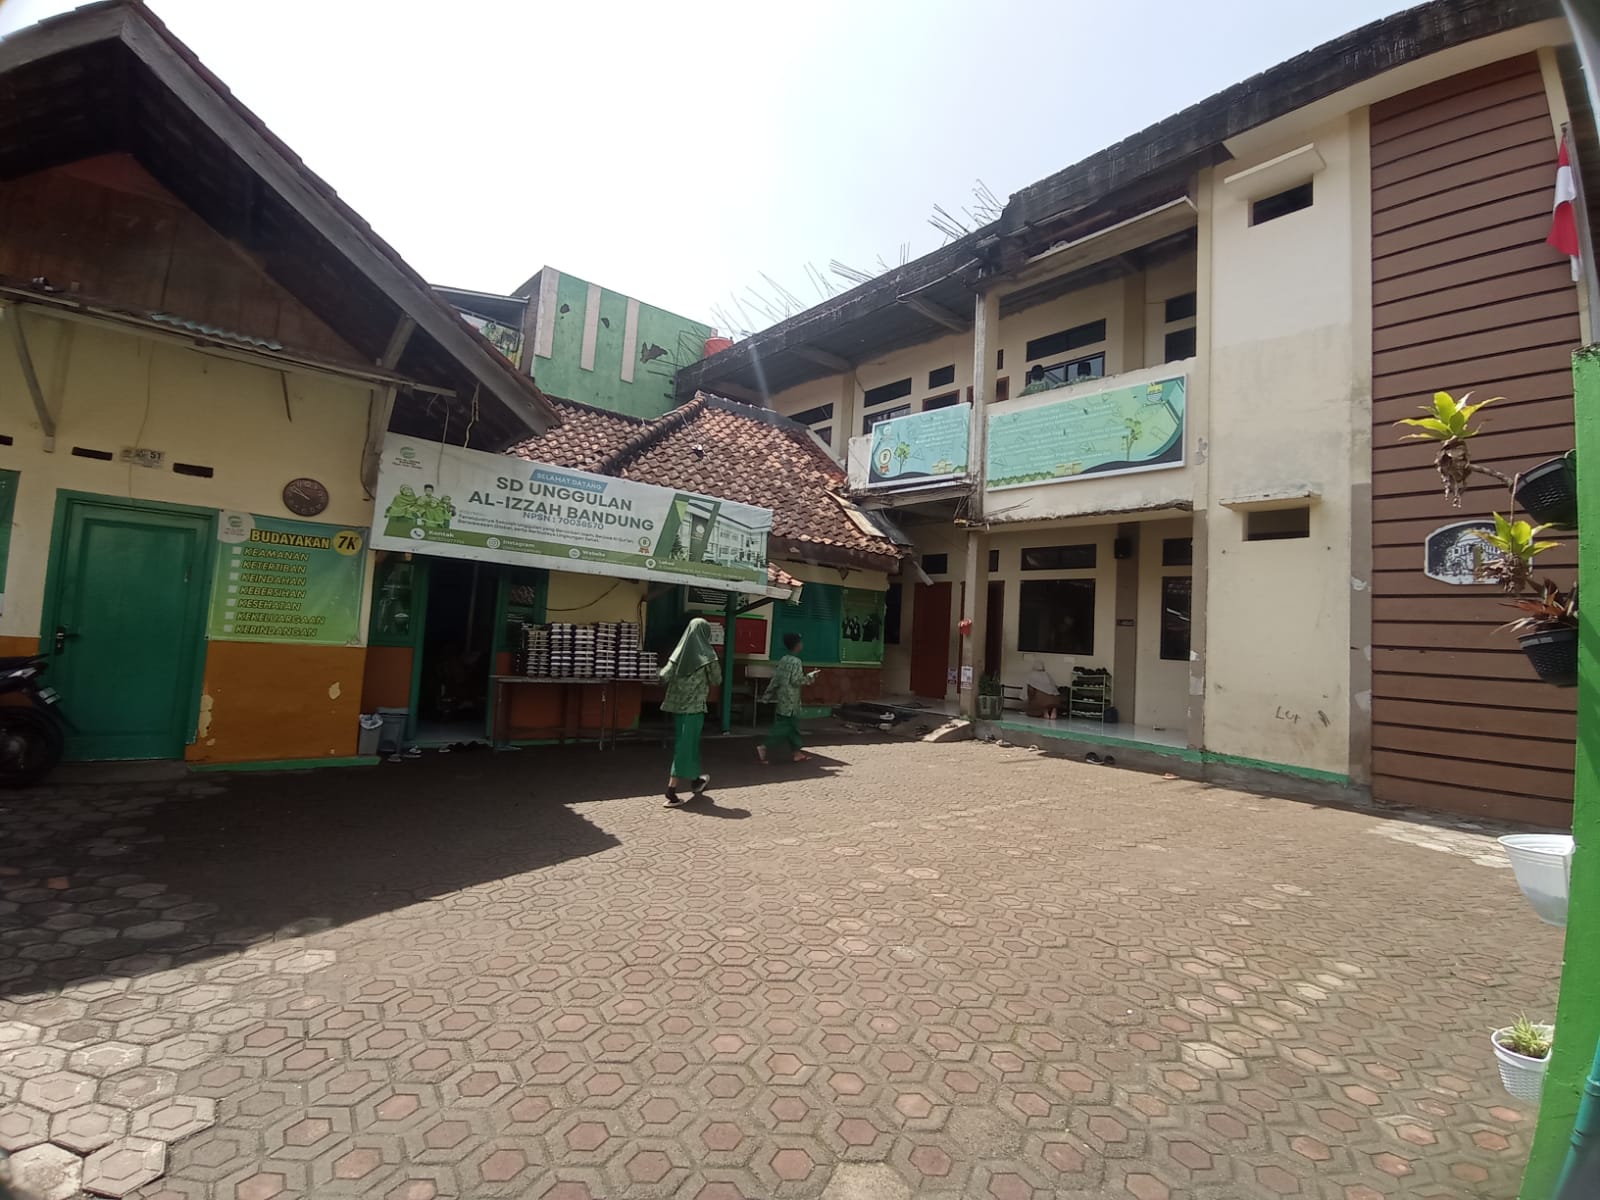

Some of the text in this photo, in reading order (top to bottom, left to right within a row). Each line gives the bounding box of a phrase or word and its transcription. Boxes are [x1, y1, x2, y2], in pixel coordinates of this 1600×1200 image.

[536, 472, 603, 491] SELAMAT DATANG
[496, 476, 632, 511] SD UNGGULAN
[468, 491, 655, 531] AL-IZZAH BANDUNG
[523, 511, 550, 523] NPSN
[249, 528, 331, 549] BUDAYAKAN
[337, 535, 359, 550] 7K
[429, 530, 455, 538] Kontak
[503, 539, 536, 549] Instagram
[243, 547, 310, 562] KEAMANAN
[241, 560, 307, 574] KETERTIBAN
[240, 573, 307, 586] KEINDAHAN
[238, 585, 307, 599] KEBERSIHAN
[236, 598, 302, 611] KESEHATAN
[235, 611, 326, 625] KEKELUARGAAN
[233, 624, 319, 638] KERINDANGAN
